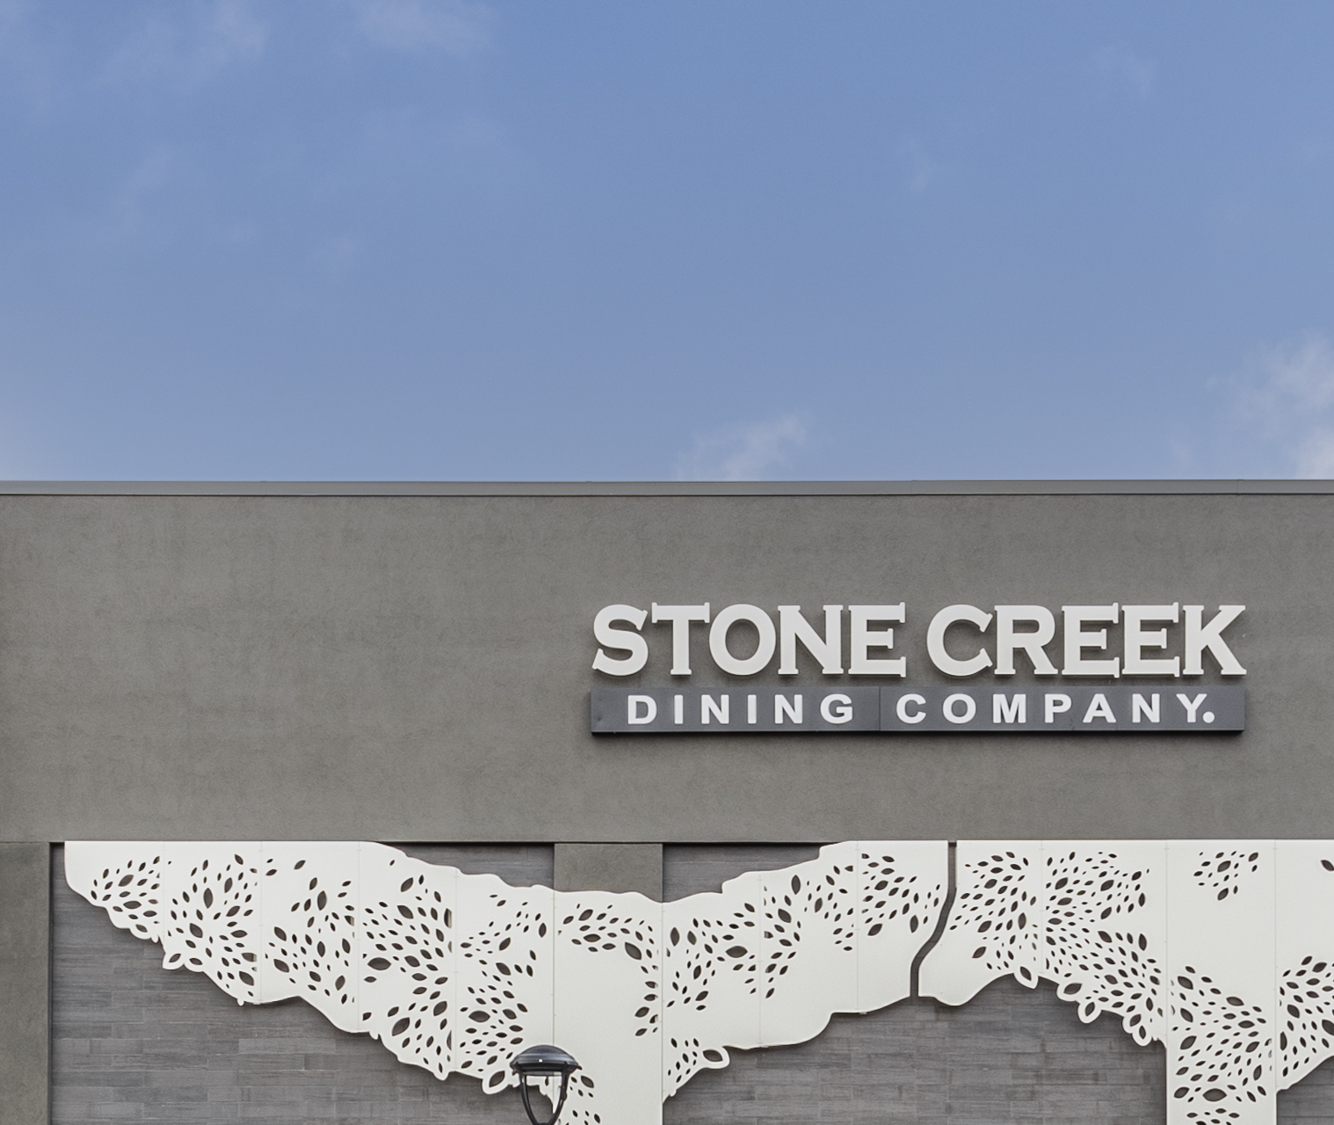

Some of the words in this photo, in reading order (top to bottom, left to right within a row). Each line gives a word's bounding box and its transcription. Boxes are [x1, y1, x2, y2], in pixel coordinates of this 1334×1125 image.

[591, 601, 907, 678] STONE
[926, 601, 1248, 679] CREEK
[626, 693, 854, 725] DINING
